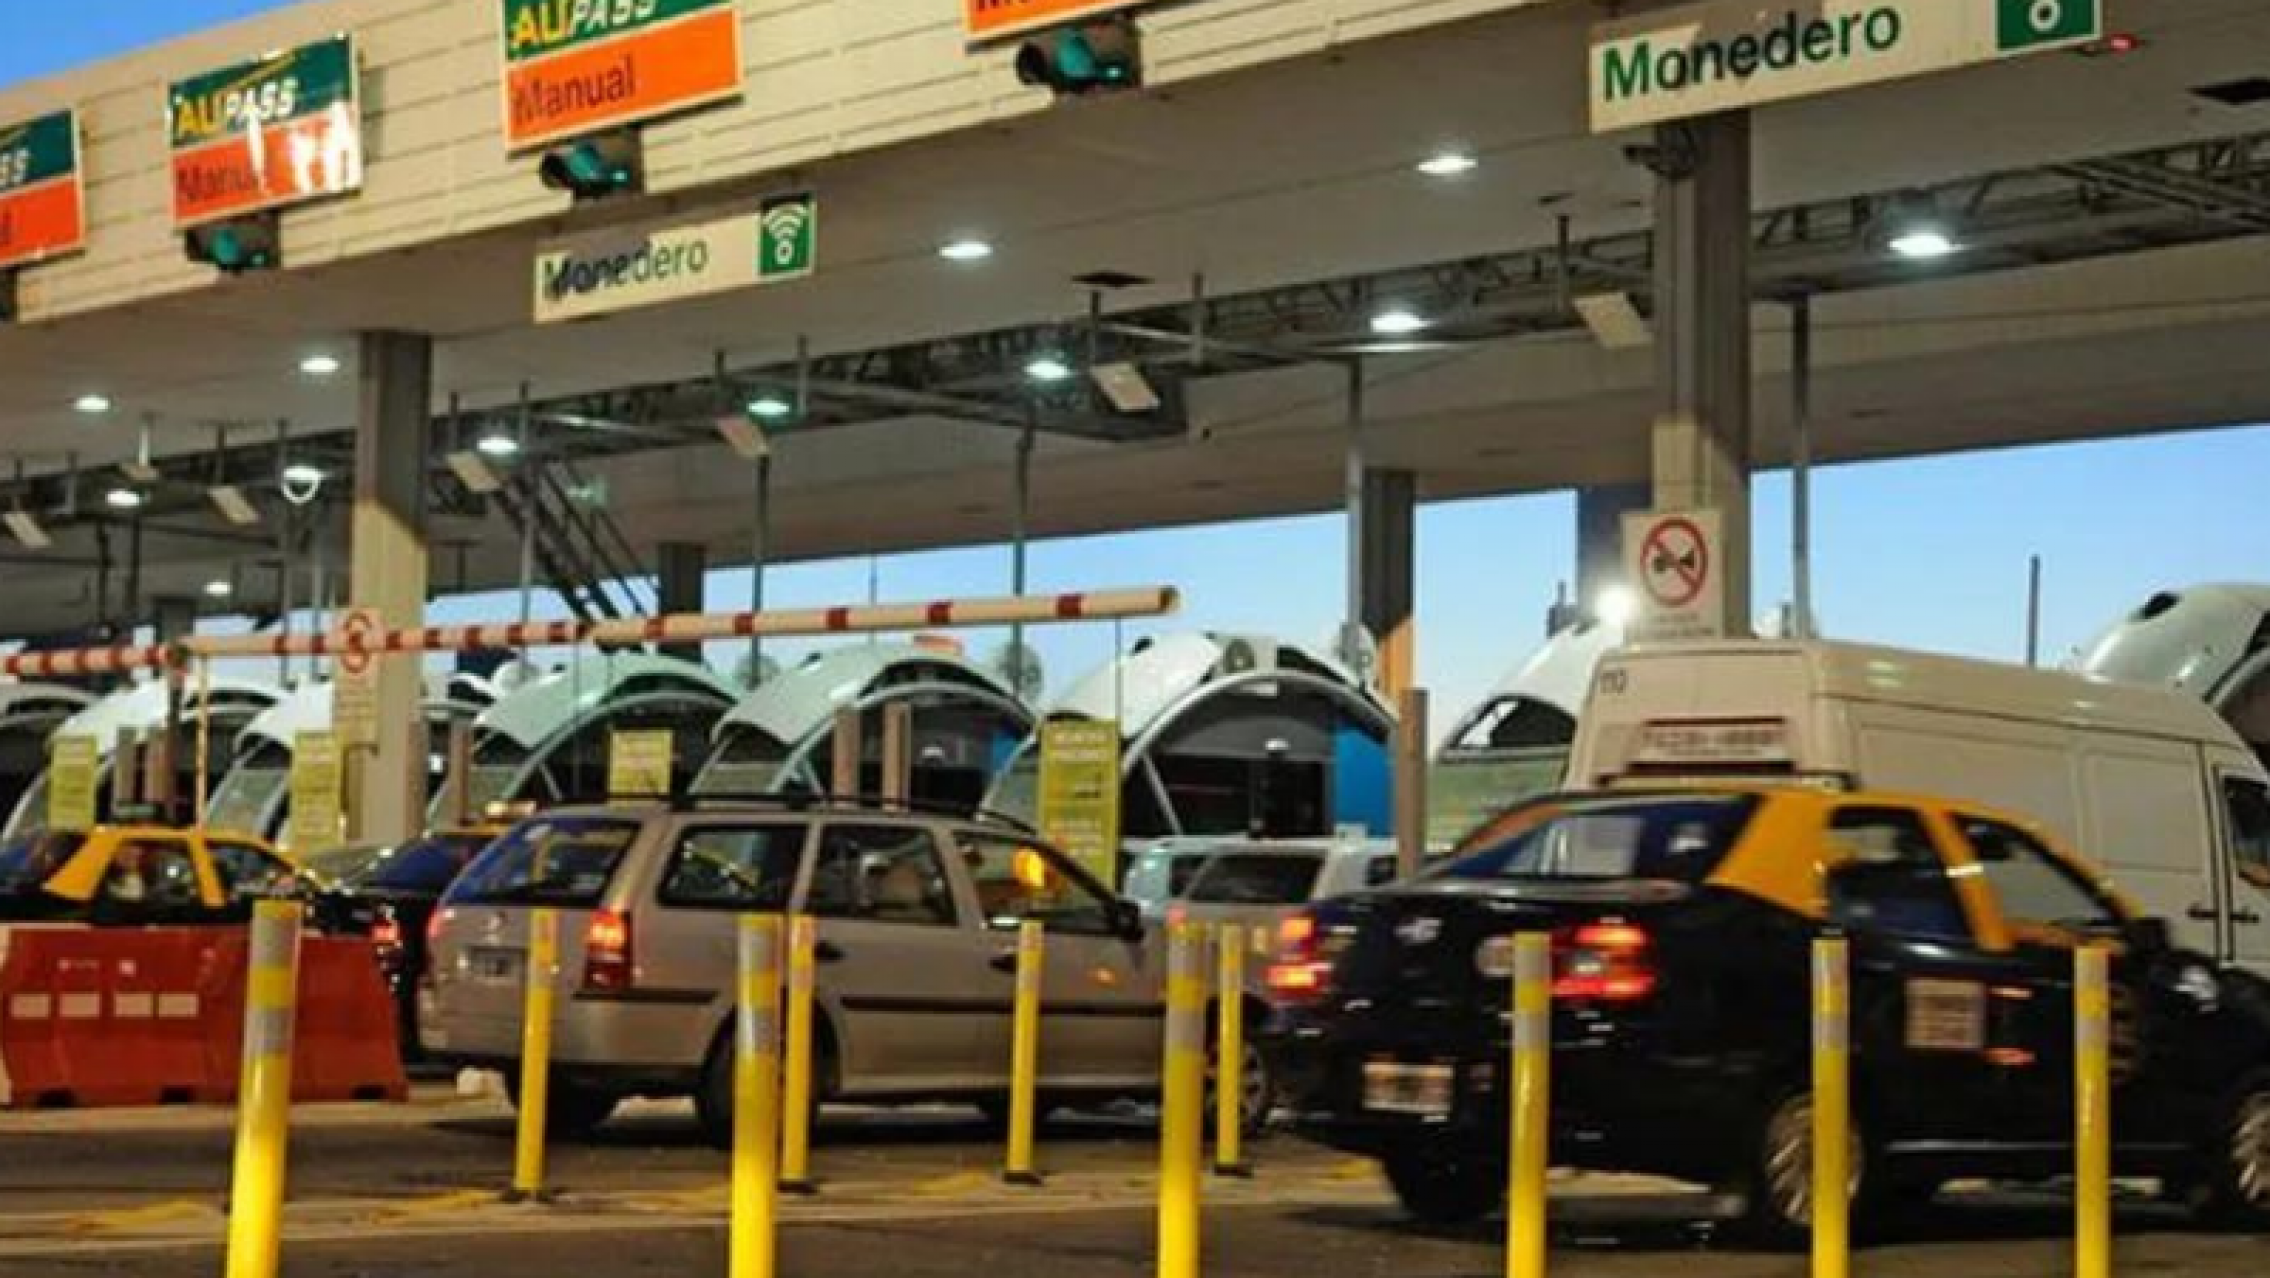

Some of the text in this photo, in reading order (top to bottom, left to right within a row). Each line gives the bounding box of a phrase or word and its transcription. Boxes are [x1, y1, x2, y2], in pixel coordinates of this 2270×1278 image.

[1602, 6, 1900, 101] Monedero
[512, 54, 635, 126] Manual
[544, 237, 709, 301] Monedero
